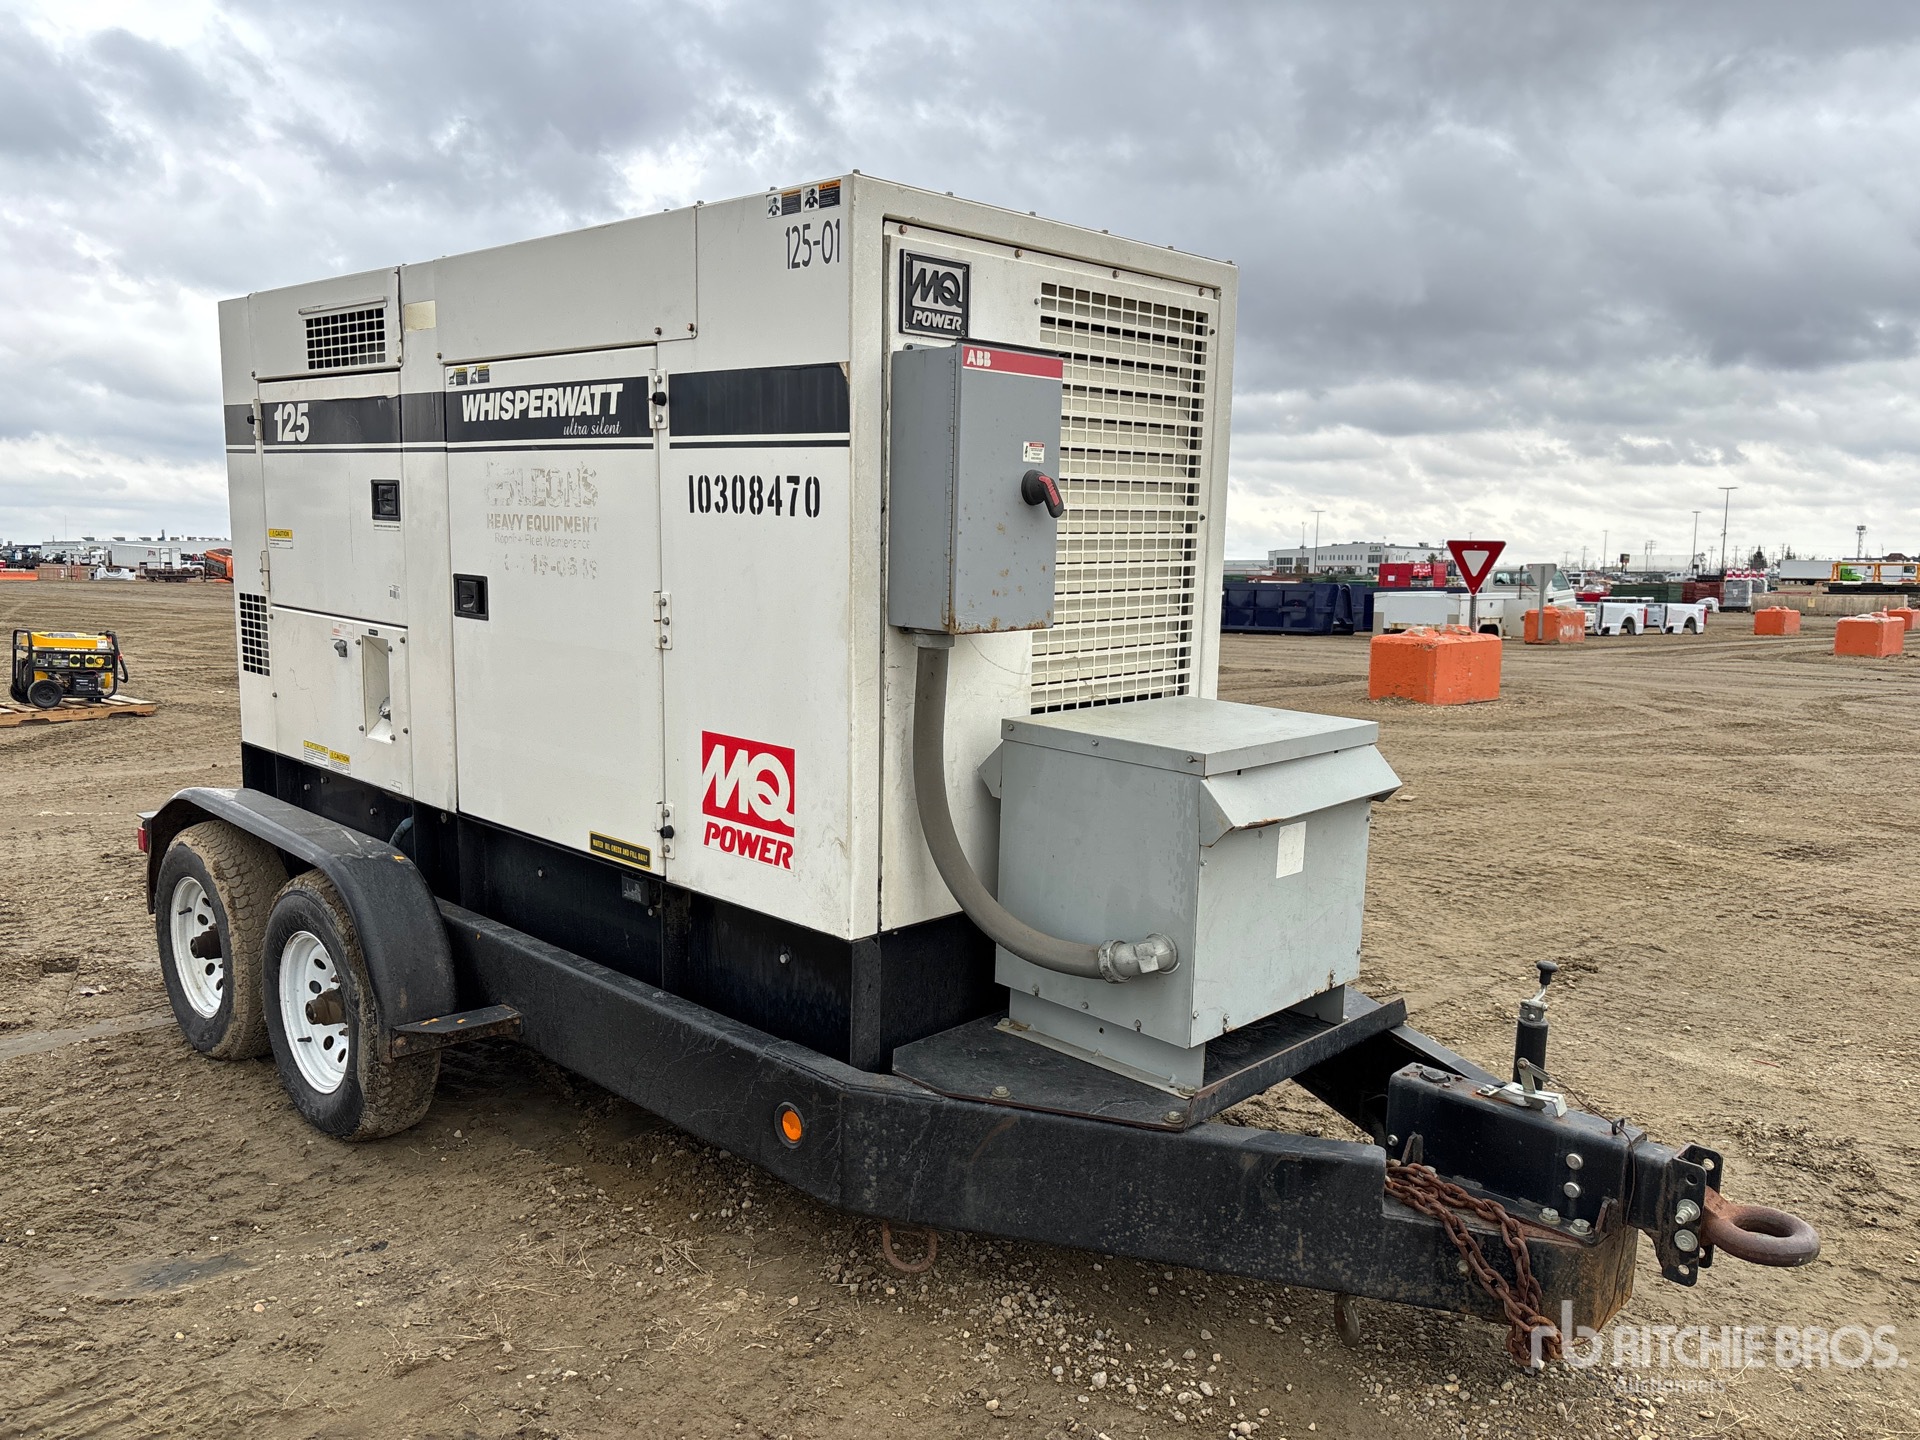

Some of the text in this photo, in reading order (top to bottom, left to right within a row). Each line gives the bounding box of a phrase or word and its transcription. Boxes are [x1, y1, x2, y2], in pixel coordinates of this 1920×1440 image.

[785, 218, 840, 270] 125-01
[909, 267, 963, 309] MQ
[912, 310, 962, 331] POWER
[966, 349, 992, 367] ABB
[462, 383, 624, 422] WHISPERWATT
[274, 403, 310, 442] 125
[563, 416, 622, 436] ultra silent
[688, 474, 821, 518] 10308470
[486, 513, 600, 534] HEAVY EQUIPMENT
[702, 743, 795, 828] MQ
[703, 821, 794, 870] POWER
